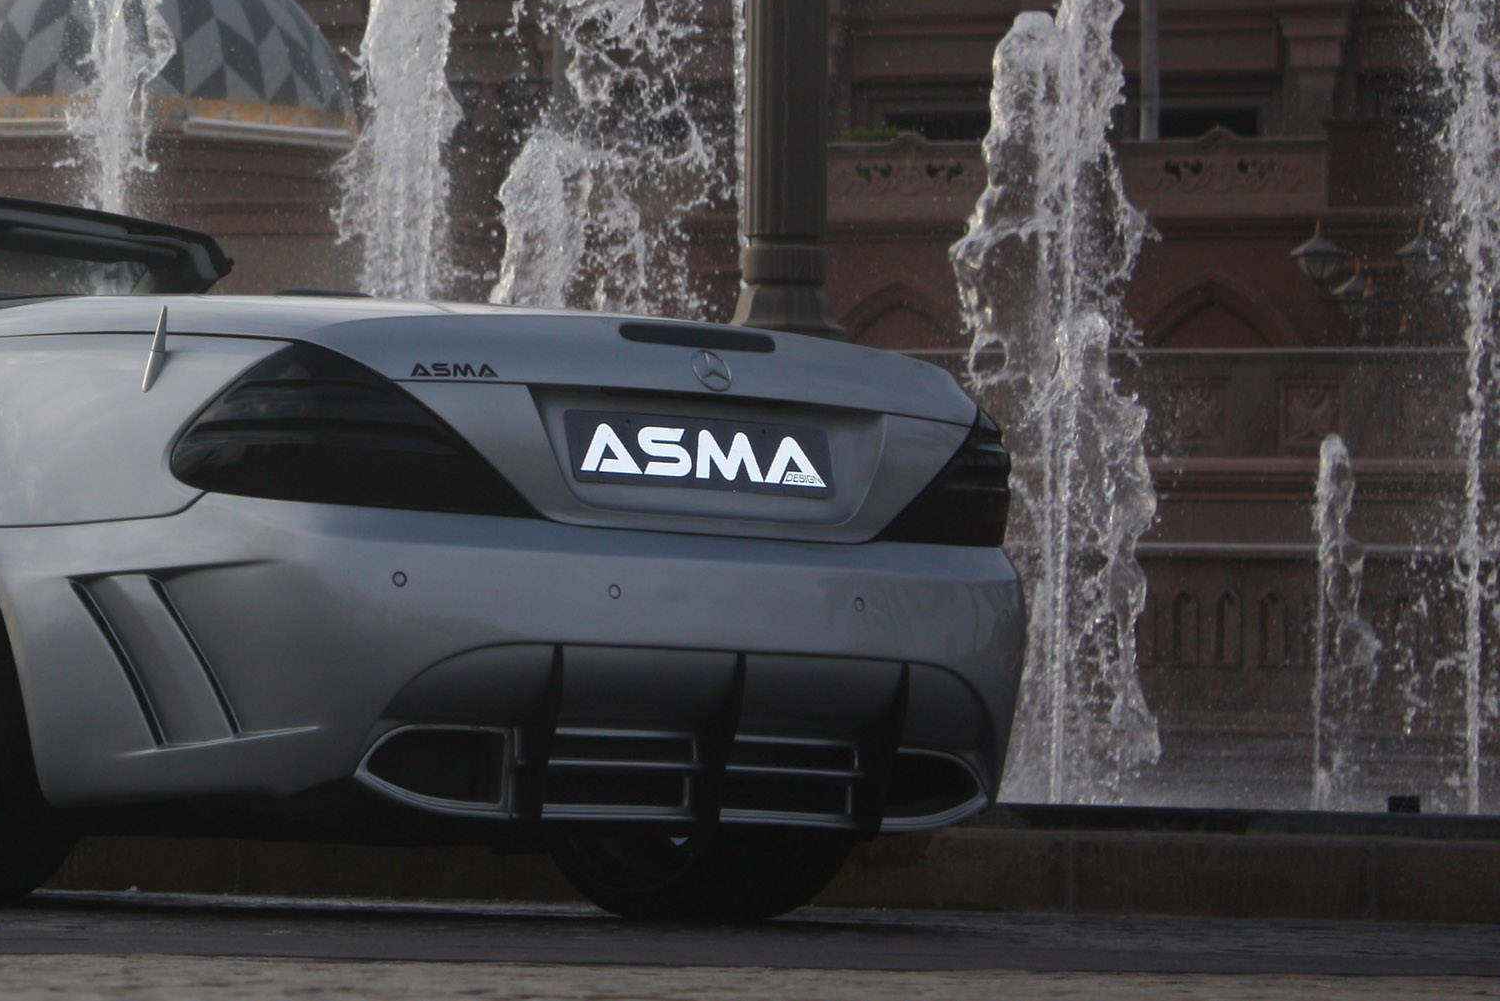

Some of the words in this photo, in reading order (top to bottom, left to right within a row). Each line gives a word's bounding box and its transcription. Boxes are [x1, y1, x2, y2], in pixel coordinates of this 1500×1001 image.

[410, 363, 499, 377] ASMA
[581, 423, 827, 488] ASMA
[785, 473, 823, 485] DESIGN
